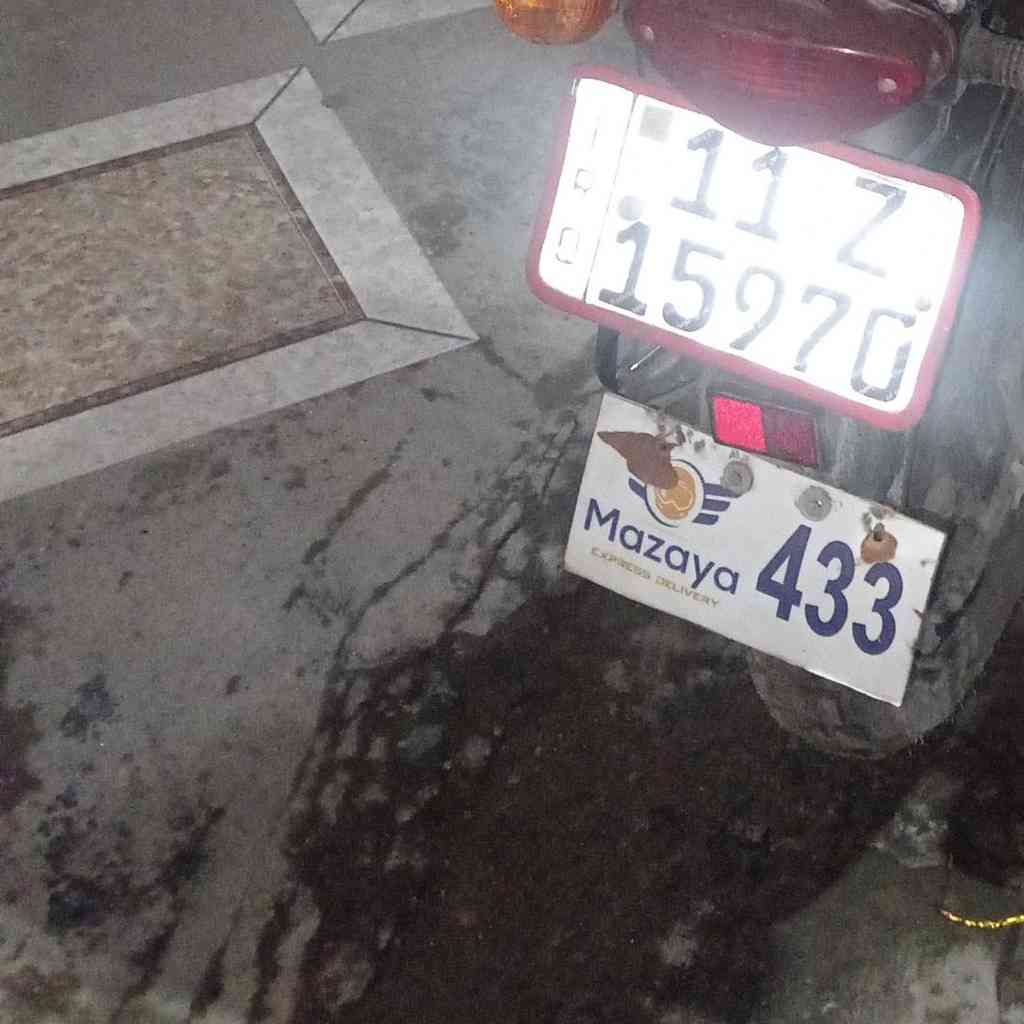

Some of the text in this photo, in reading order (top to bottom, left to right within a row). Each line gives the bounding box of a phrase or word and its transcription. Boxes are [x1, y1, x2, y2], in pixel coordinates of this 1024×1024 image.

[670, 128, 908, 278] 11 Z
[598, 221, 917, 403] 15970
[583, 498, 740, 595] Mazaya
[590, 546, 721, 609] EXPRESS DELIVERY
[755, 523, 904, 656] 433
